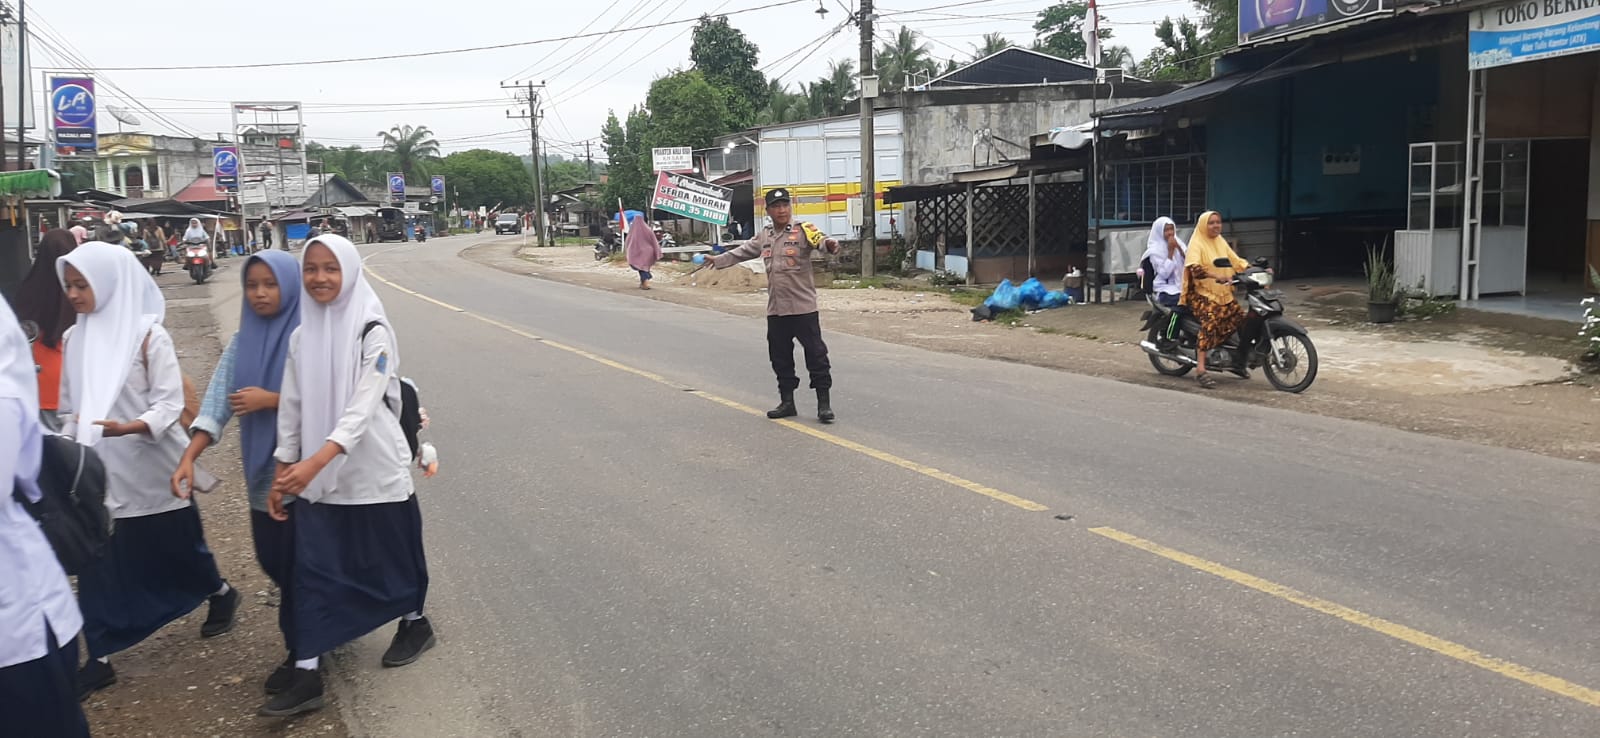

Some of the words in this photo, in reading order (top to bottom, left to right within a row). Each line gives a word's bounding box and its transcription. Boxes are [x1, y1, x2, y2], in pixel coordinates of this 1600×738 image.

[1496, 2, 1538, 26] TOKO
[656, 197, 686, 212] SERBA
[688, 205, 700, 215] 35
[702, 209, 725, 221] RIBU
[660, 186, 690, 200] SERBA
[692, 194, 727, 210] MURAH
